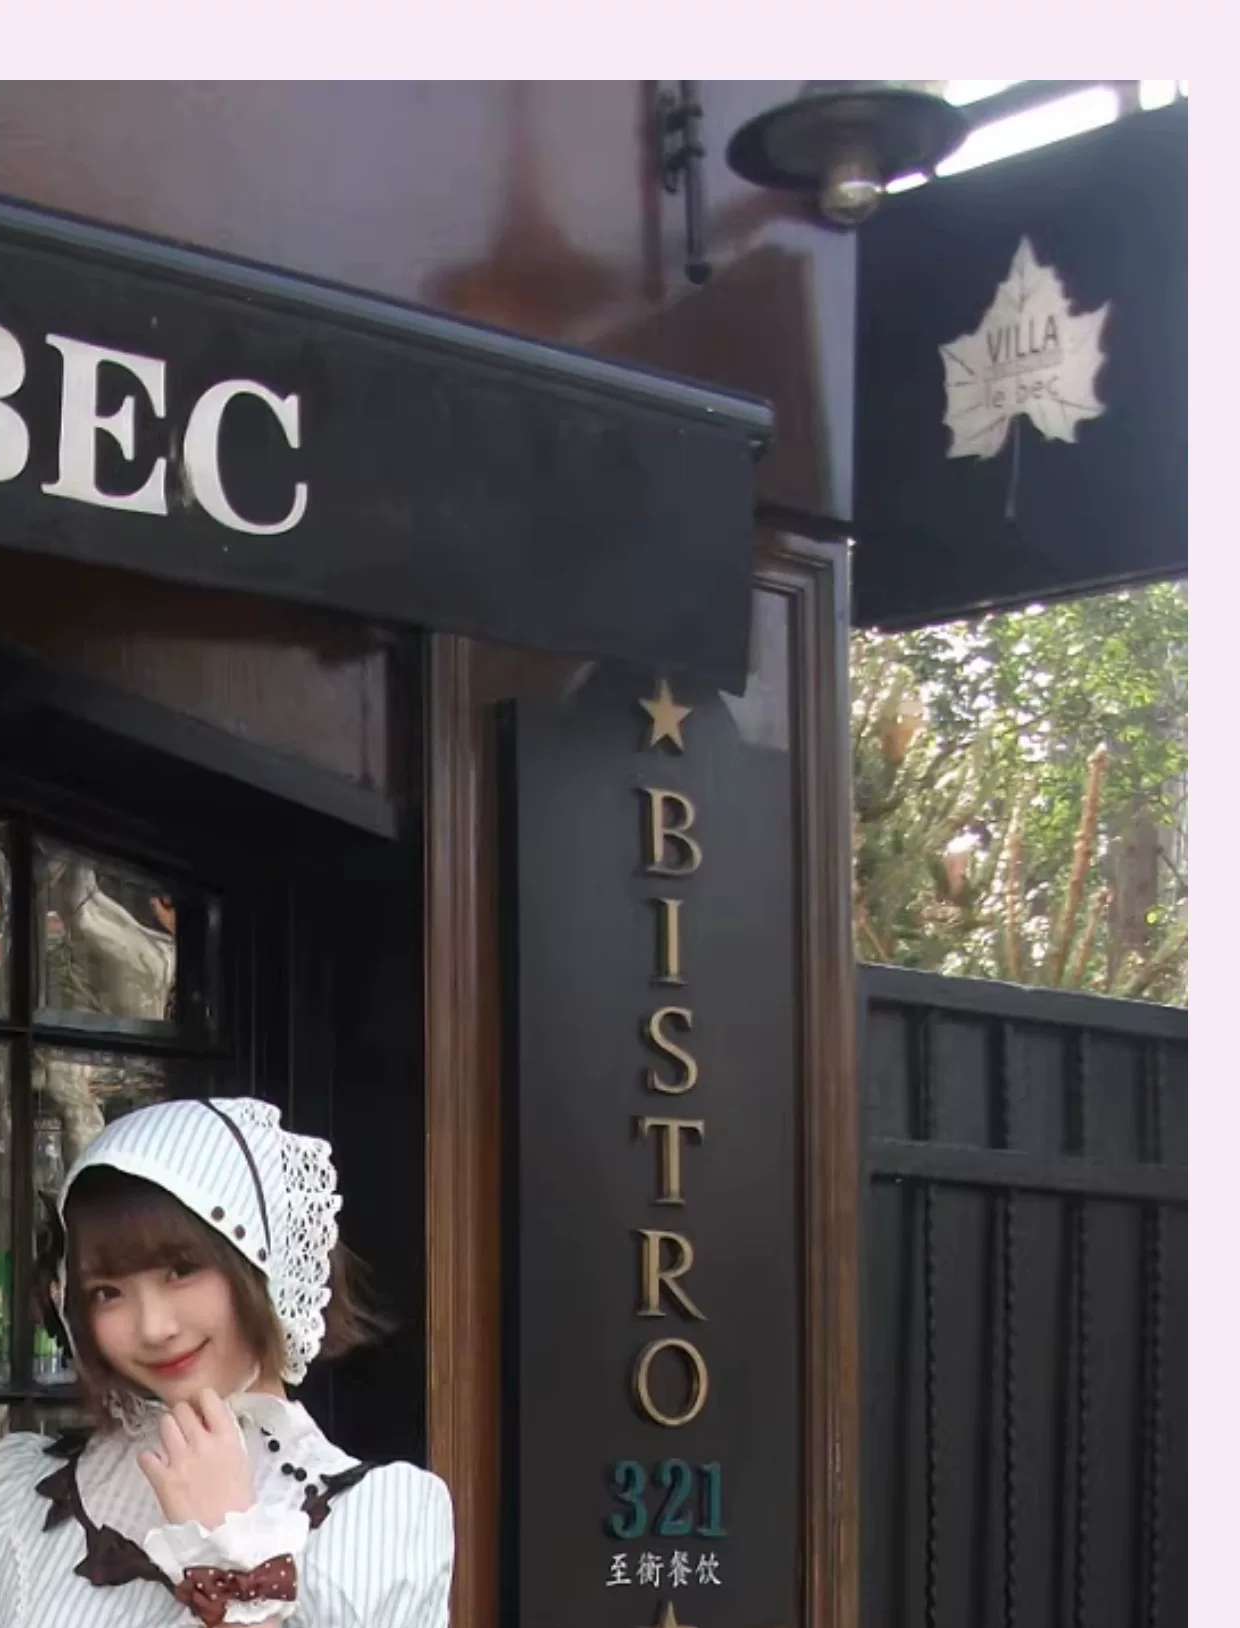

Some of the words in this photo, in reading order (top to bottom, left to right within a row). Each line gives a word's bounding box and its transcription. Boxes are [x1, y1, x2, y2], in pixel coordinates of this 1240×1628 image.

[986, 314, 1060, 363] VILLA
[635, 786, 709, 1427] BISTRO
[609, 1458, 729, 1540] 321
